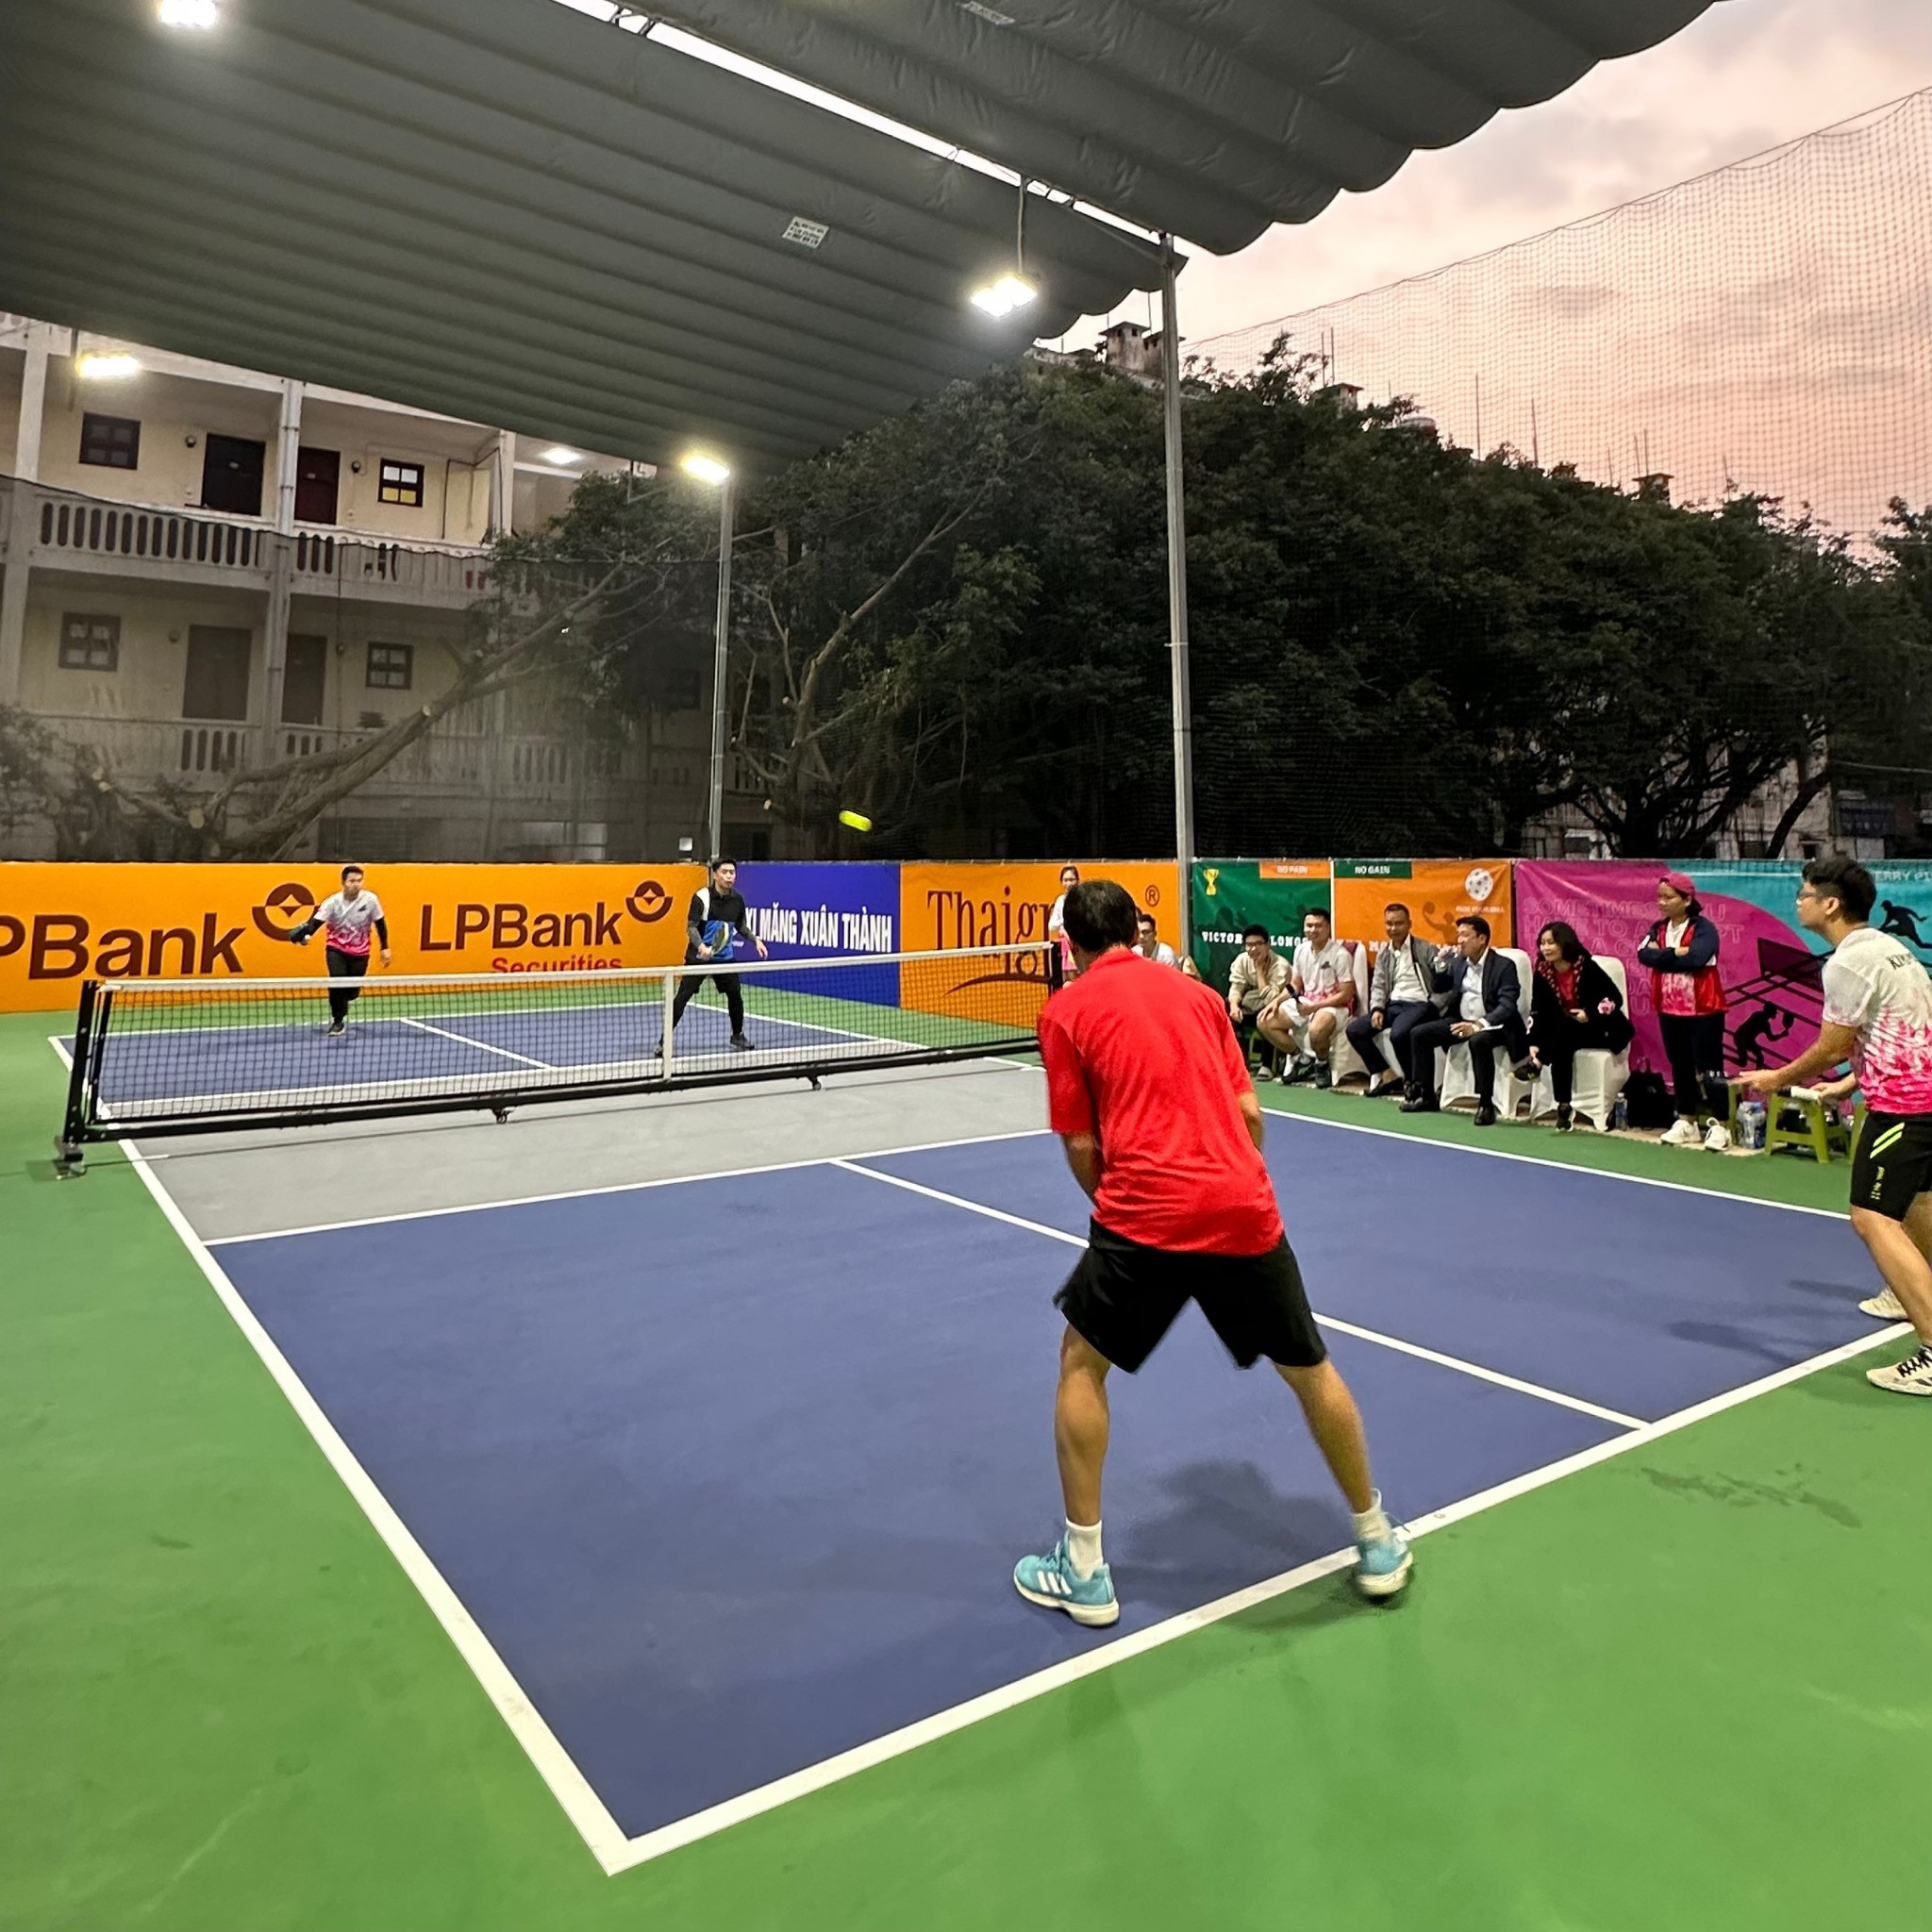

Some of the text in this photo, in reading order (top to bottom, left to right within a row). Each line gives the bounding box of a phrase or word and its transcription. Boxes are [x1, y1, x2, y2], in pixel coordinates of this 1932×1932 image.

[1355, 865, 1391, 874] NO GAIN
[420, 901, 624, 951] LPBank
[759, 902, 798, 944] MĂNG
[800, 904, 839, 948] XUÂN
[841, 906, 892, 953] THÀNH
[491, 954, 624, 974] Securities
